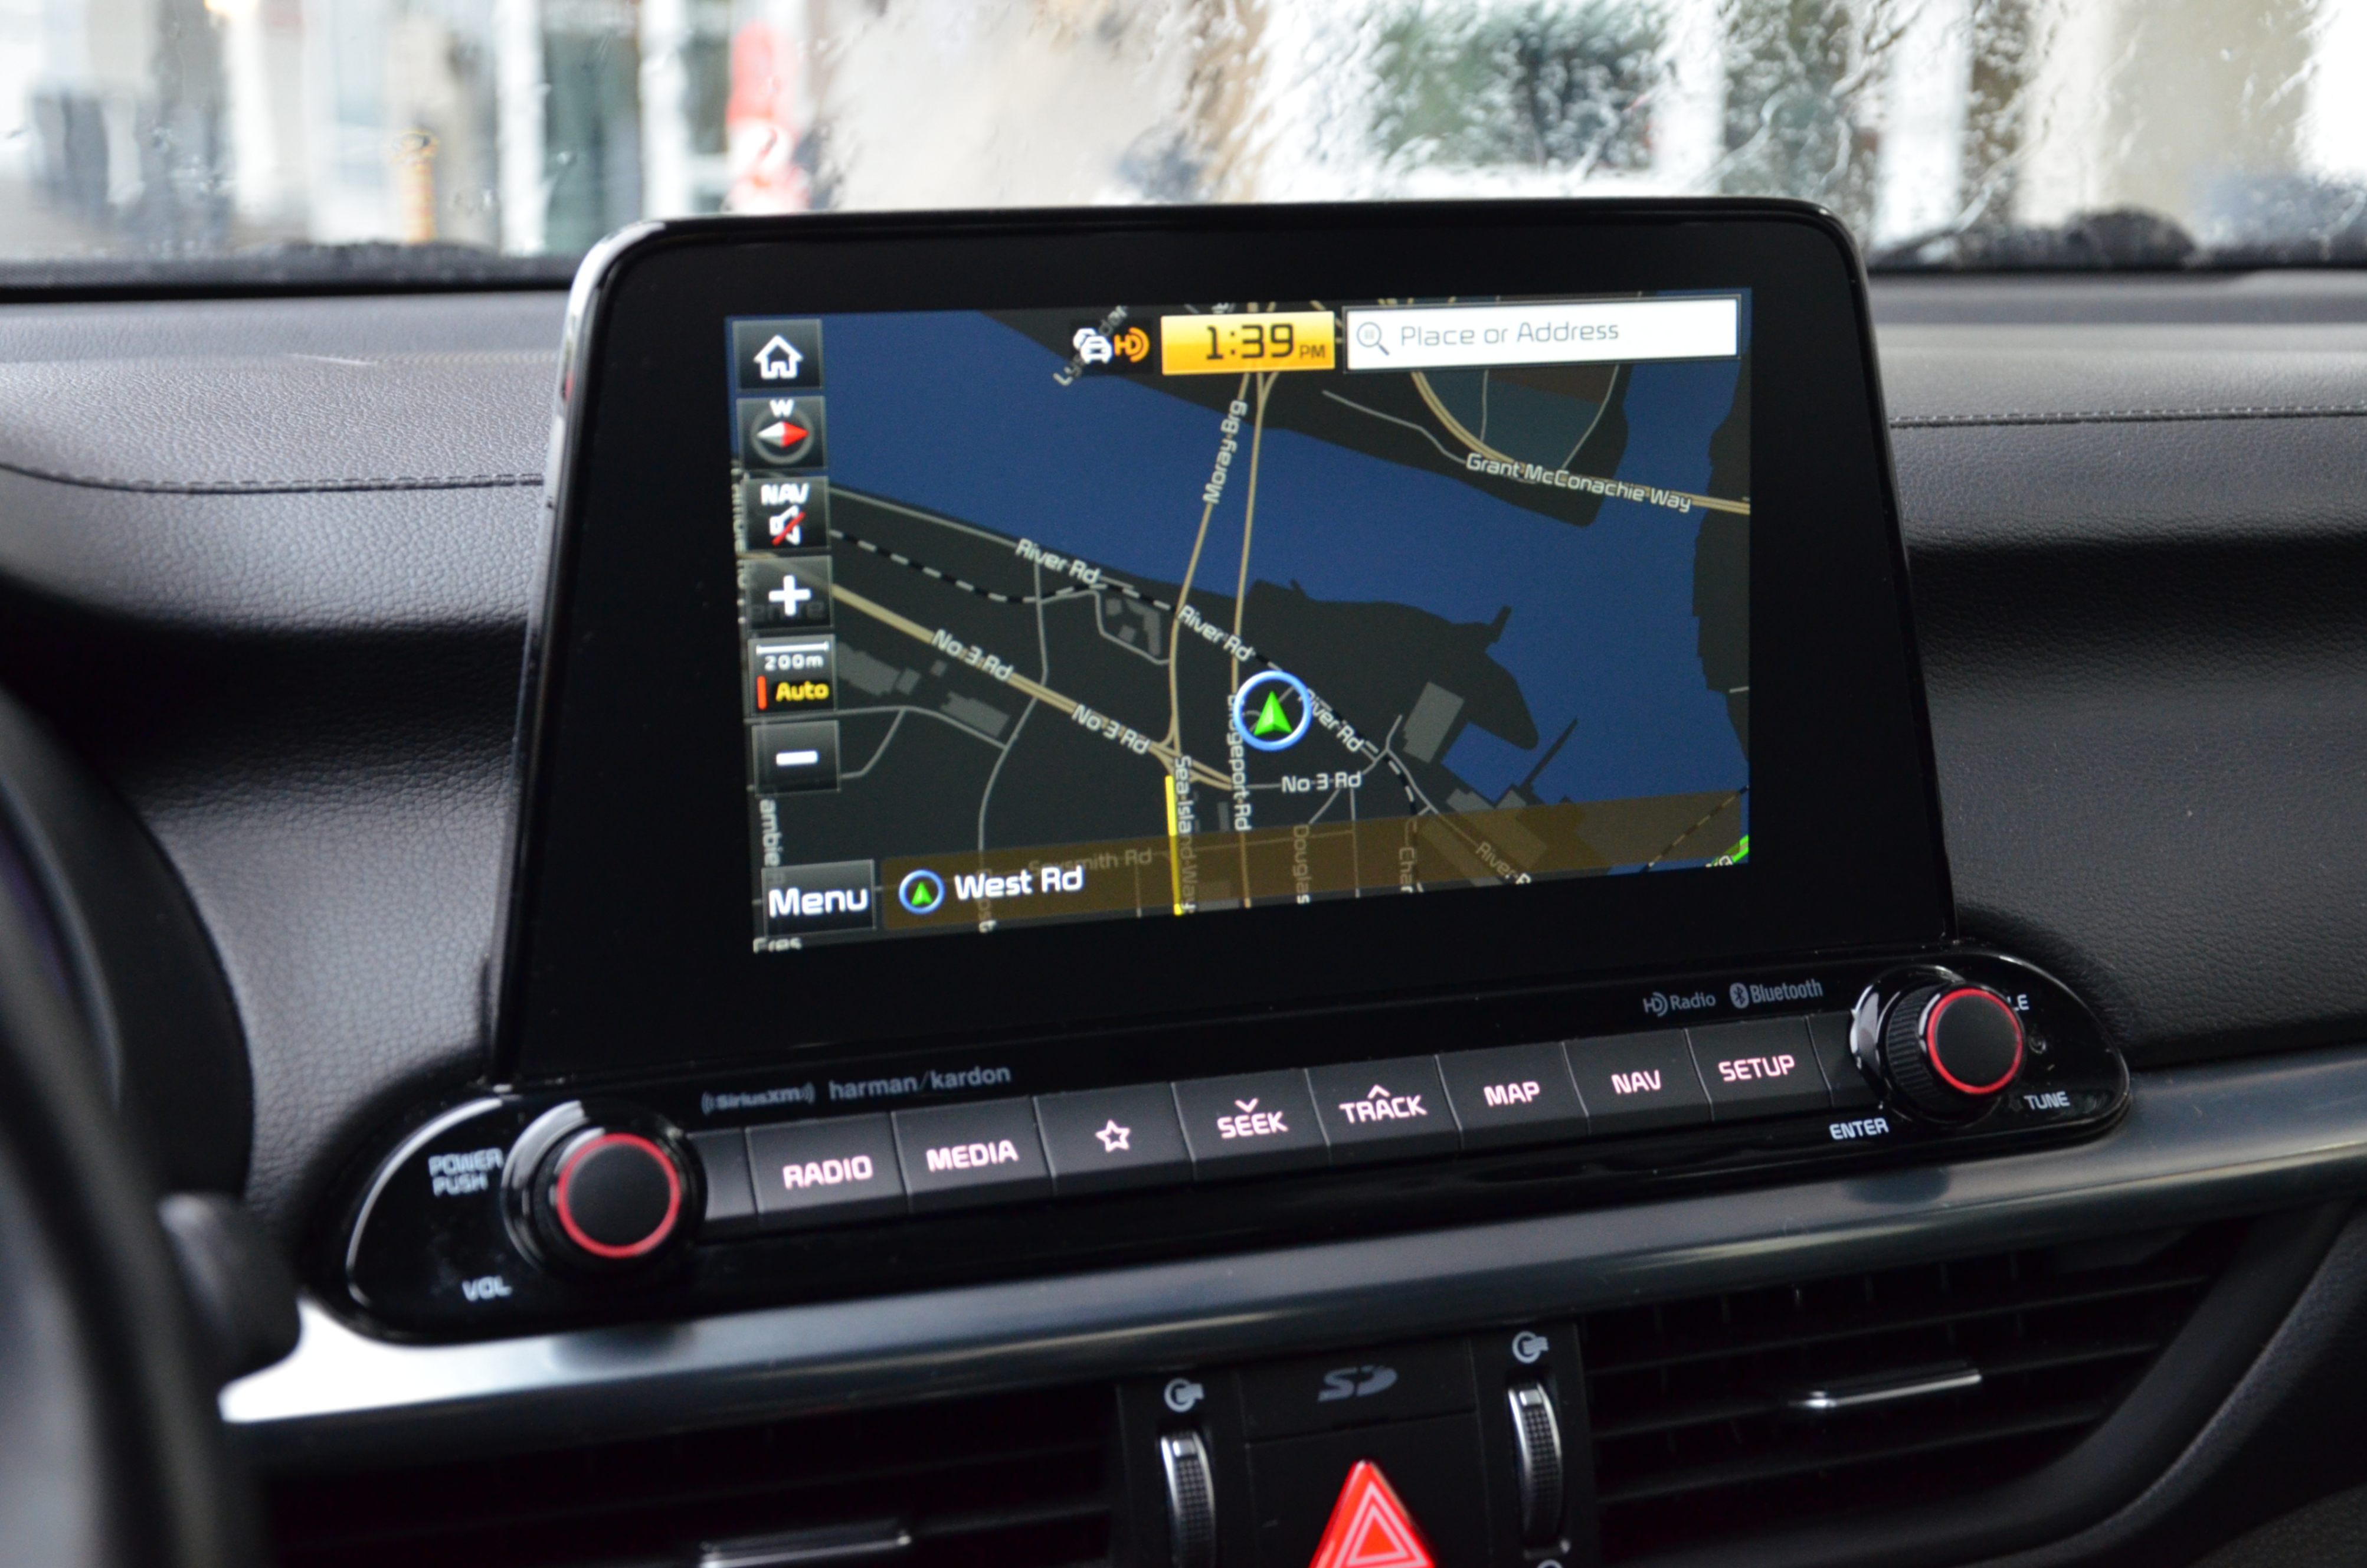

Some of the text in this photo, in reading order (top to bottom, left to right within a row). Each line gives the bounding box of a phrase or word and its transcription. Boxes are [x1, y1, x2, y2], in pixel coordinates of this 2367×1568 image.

[1206, 323, 1327, 360] 1:39 PM
[1400, 322, 1619, 346] Place or Address
[769, 399, 795, 417] W
[1202, 400, 1248, 505] Moray Brg
[761, 483, 810, 506] NAV
[1466, 452, 1692, 513] Grant McConachie Way
[1015, 538, 1101, 585] River Rd
[1177, 604, 1255, 662] River Rd
[764, 653, 824, 671] 200m
[931, 628, 1013, 682] No 3 Rd
[775, 680, 830, 702] Auto
[1071, 703, 1151, 755] No 3 Rd
[1336, 724, 1365, 752] Rd
[1176, 755, 1192, 795] Sea
[1281, 771, 1362, 793] No 3 Rd
[1177, 799, 1198, 860] Island
[1234, 803, 1253, 832] Rd
[759, 798, 783, 868] ambie
[1124, 848, 1152, 866] Rd
[1292, 824, 1312, 905] Douglas
[954, 864, 1084, 900] West Rd
[768, 886, 869, 919] Menu
[1669, 992, 1717, 1011] Radio
[1750, 978, 1823, 1003] Bluetooth
[1611, 1070, 1662, 1094] NAV
[1719, 1055, 1795, 1082] SETUP
[829, 1066, 1011, 1101] harman/kardon
[1484, 1082, 1540, 1107] MAP
[1339, 1095, 1427, 1124] TRACK
[2024, 1091, 2070, 1110] TUNE
[1217, 1111, 1289, 1140] SEEK
[1829, 1118, 1889, 1140] ENTER
[428, 1148, 503, 1178] POWER
[926, 1140, 1020, 1173] MEDIA
[432, 1173, 489, 1196] PUSH
[783, 1154, 874, 1190] RADIO
[462, 1275, 512, 1301] VOL
[1317, 1365, 1399, 1402] SD
